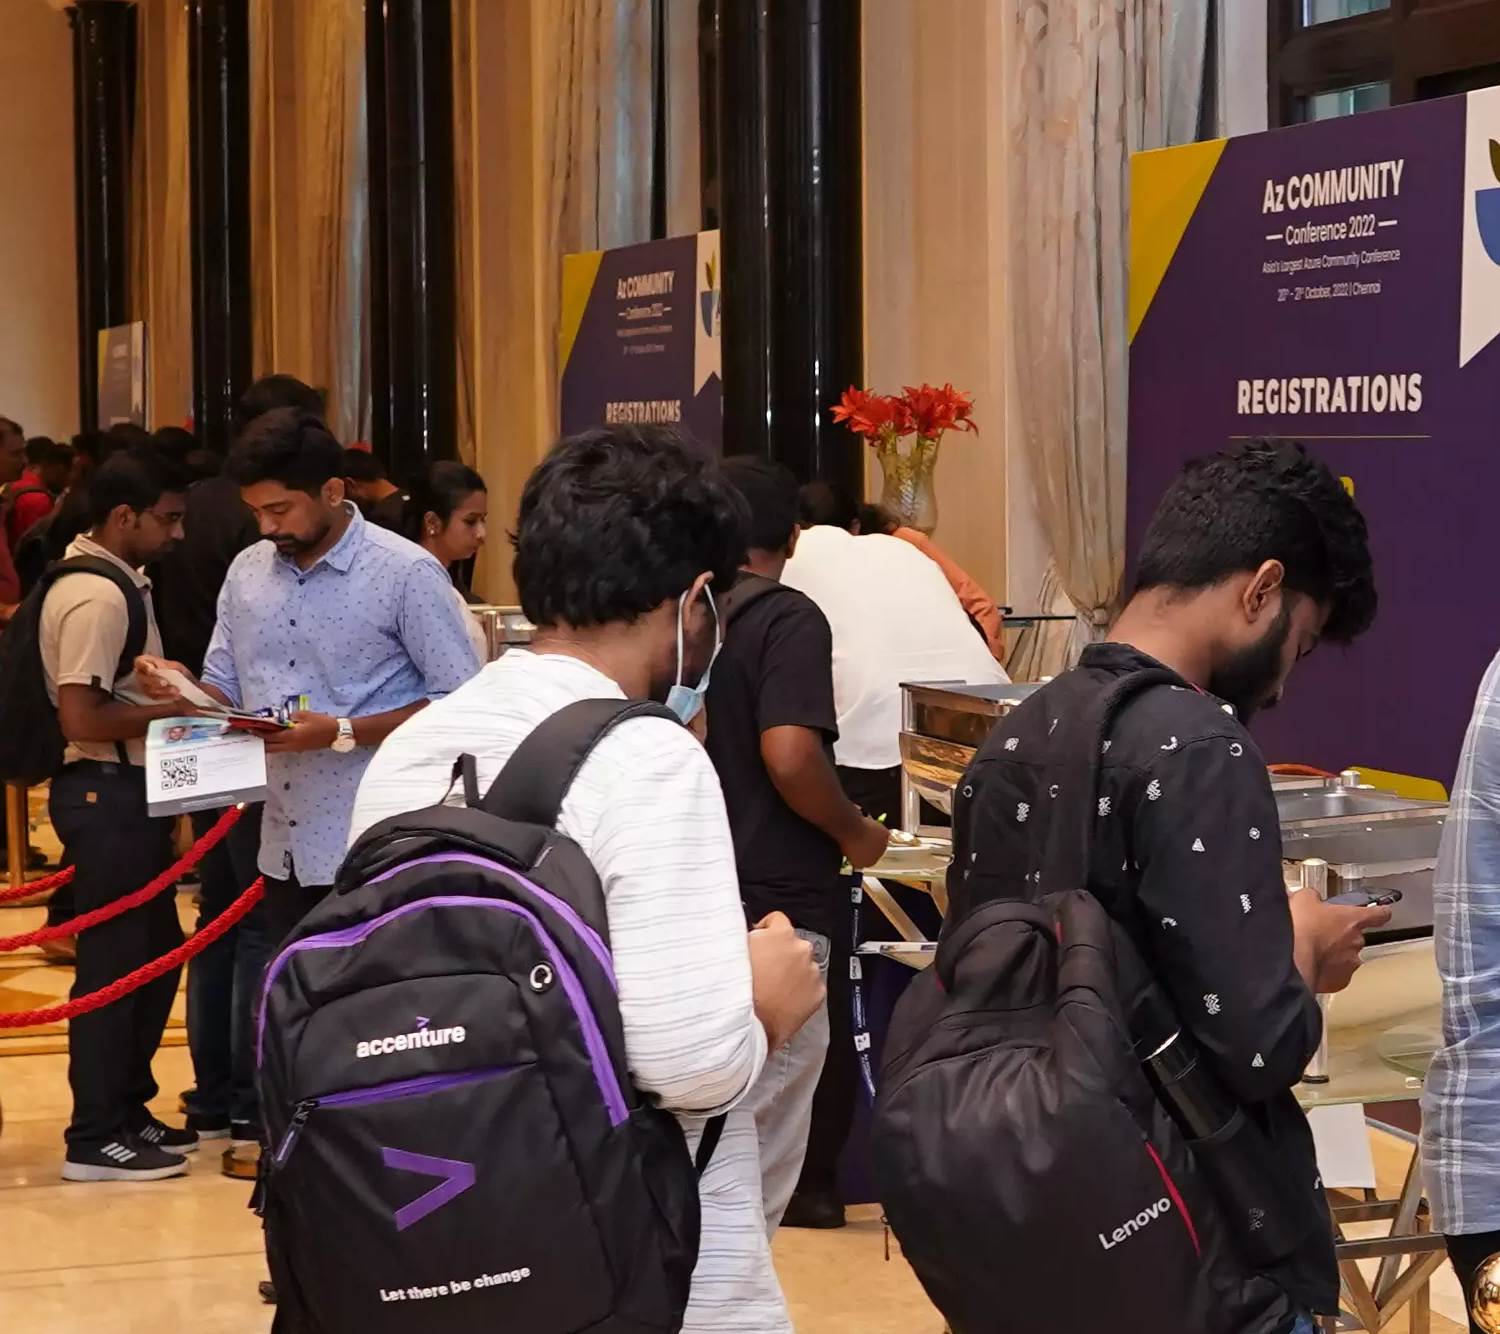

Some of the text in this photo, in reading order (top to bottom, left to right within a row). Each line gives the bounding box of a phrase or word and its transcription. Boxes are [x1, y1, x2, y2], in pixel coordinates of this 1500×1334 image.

[1262, 158, 1405, 214] Az COMMUNITY
[1285, 213, 1376, 246] Conference 2022
[1322, 251, 1360, 269] Community
[1360, 247, 1401, 264] Conference
[1237, 372, 1423, 415] REGISTRATIONS
[606, 399, 681, 424] REGISTRATIONS
[356, 1024, 466, 1058] accenture
[1098, 1196, 1172, 1251] Lenovo
[379, 1266, 532, 1302] Let there be change
